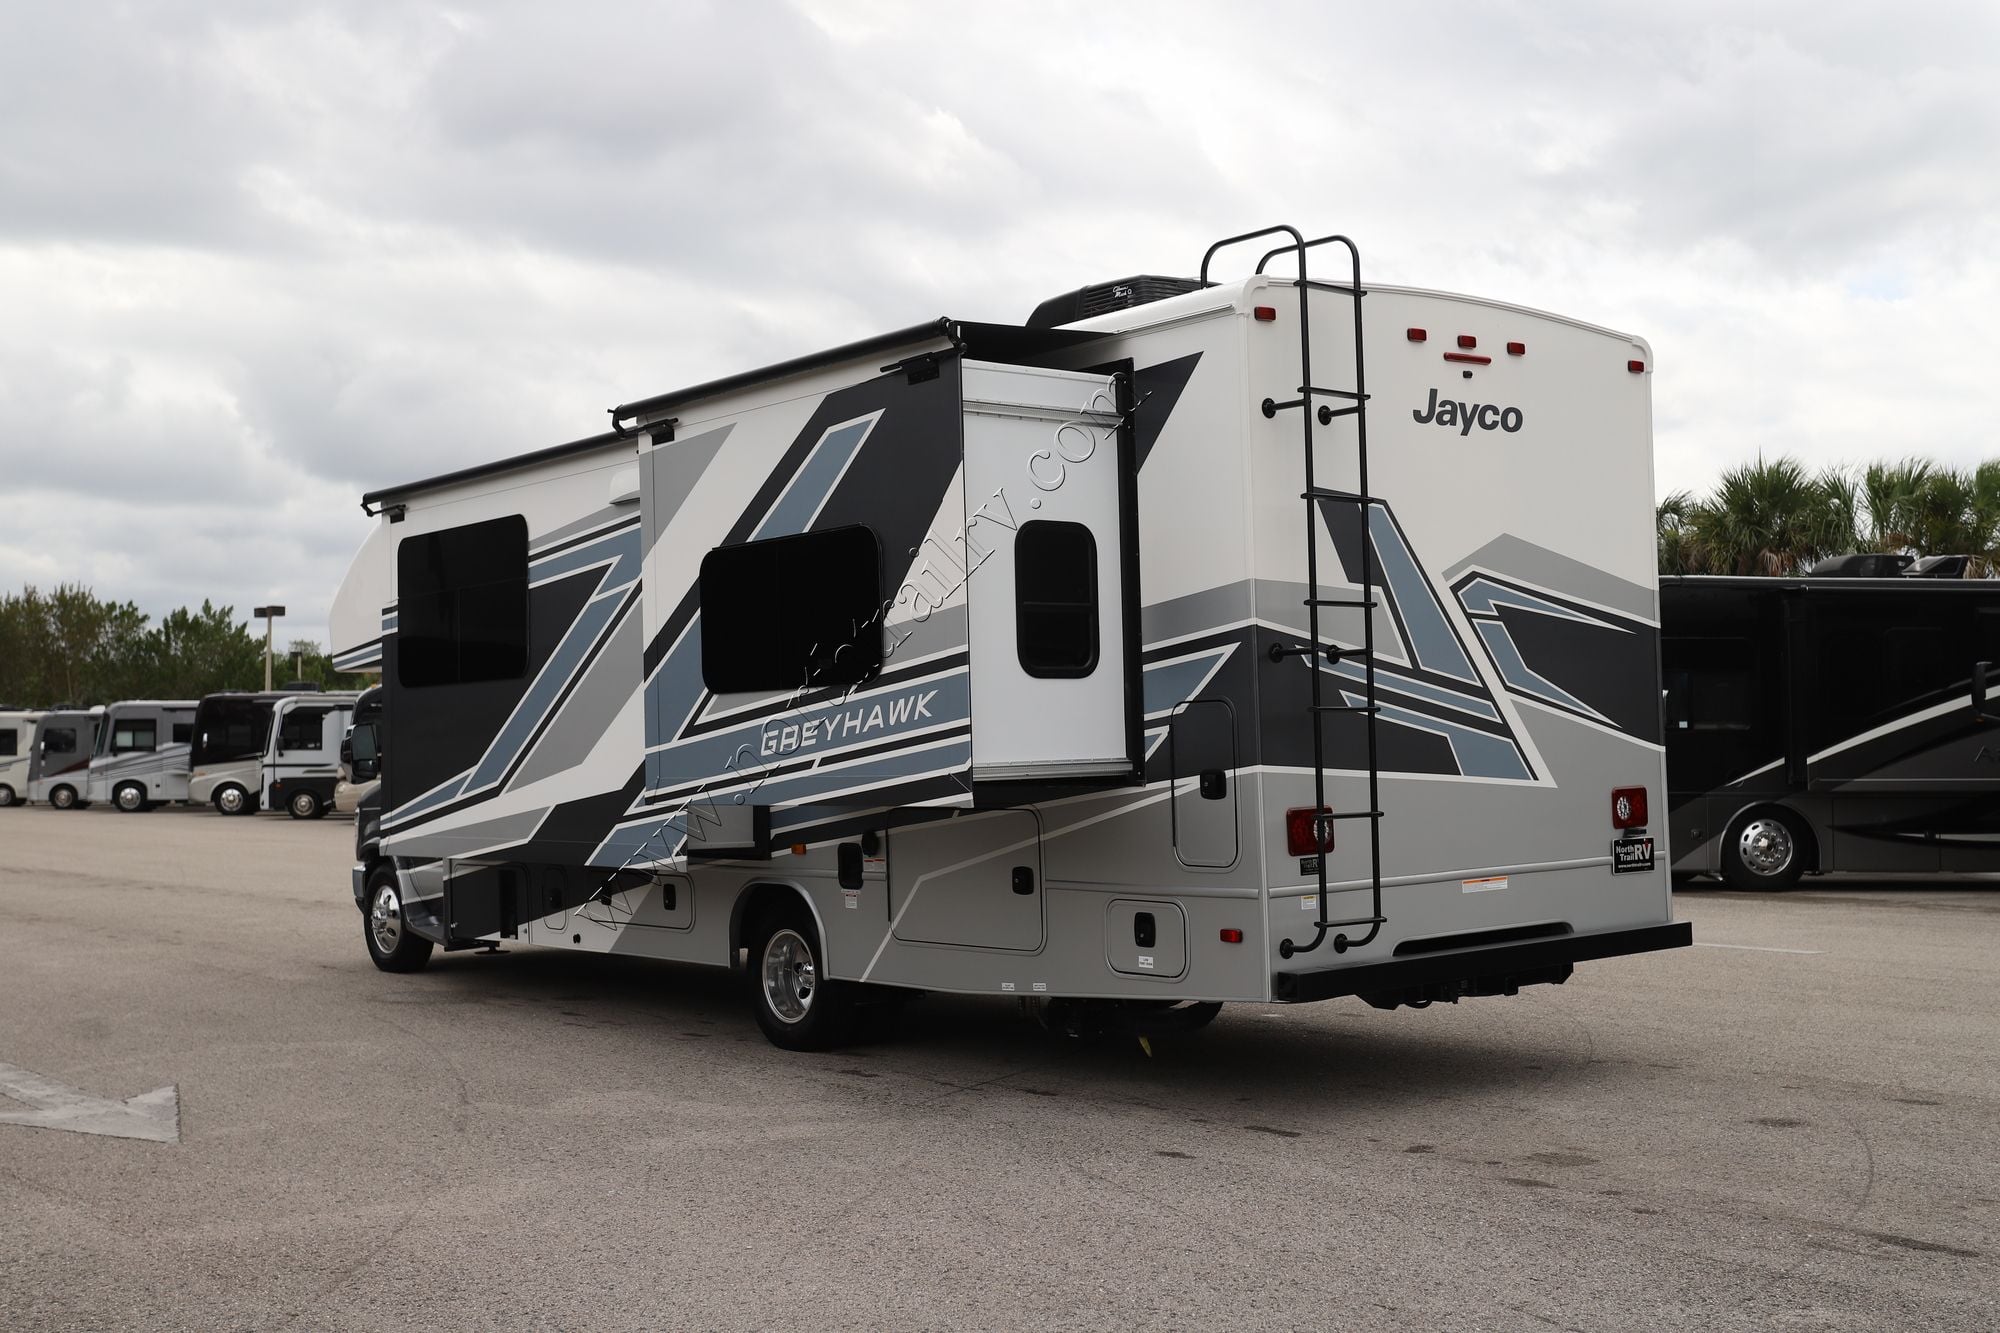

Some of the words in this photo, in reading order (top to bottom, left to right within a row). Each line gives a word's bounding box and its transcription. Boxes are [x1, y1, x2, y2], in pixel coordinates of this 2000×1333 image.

[1412, 388, 1523, 436] Jayco
[760, 689, 939, 757] GREYHAWK
[1615, 845, 1634, 854] North
[1620, 853, 1634, 861] Trail
[1634, 844, 1651, 860] RV
